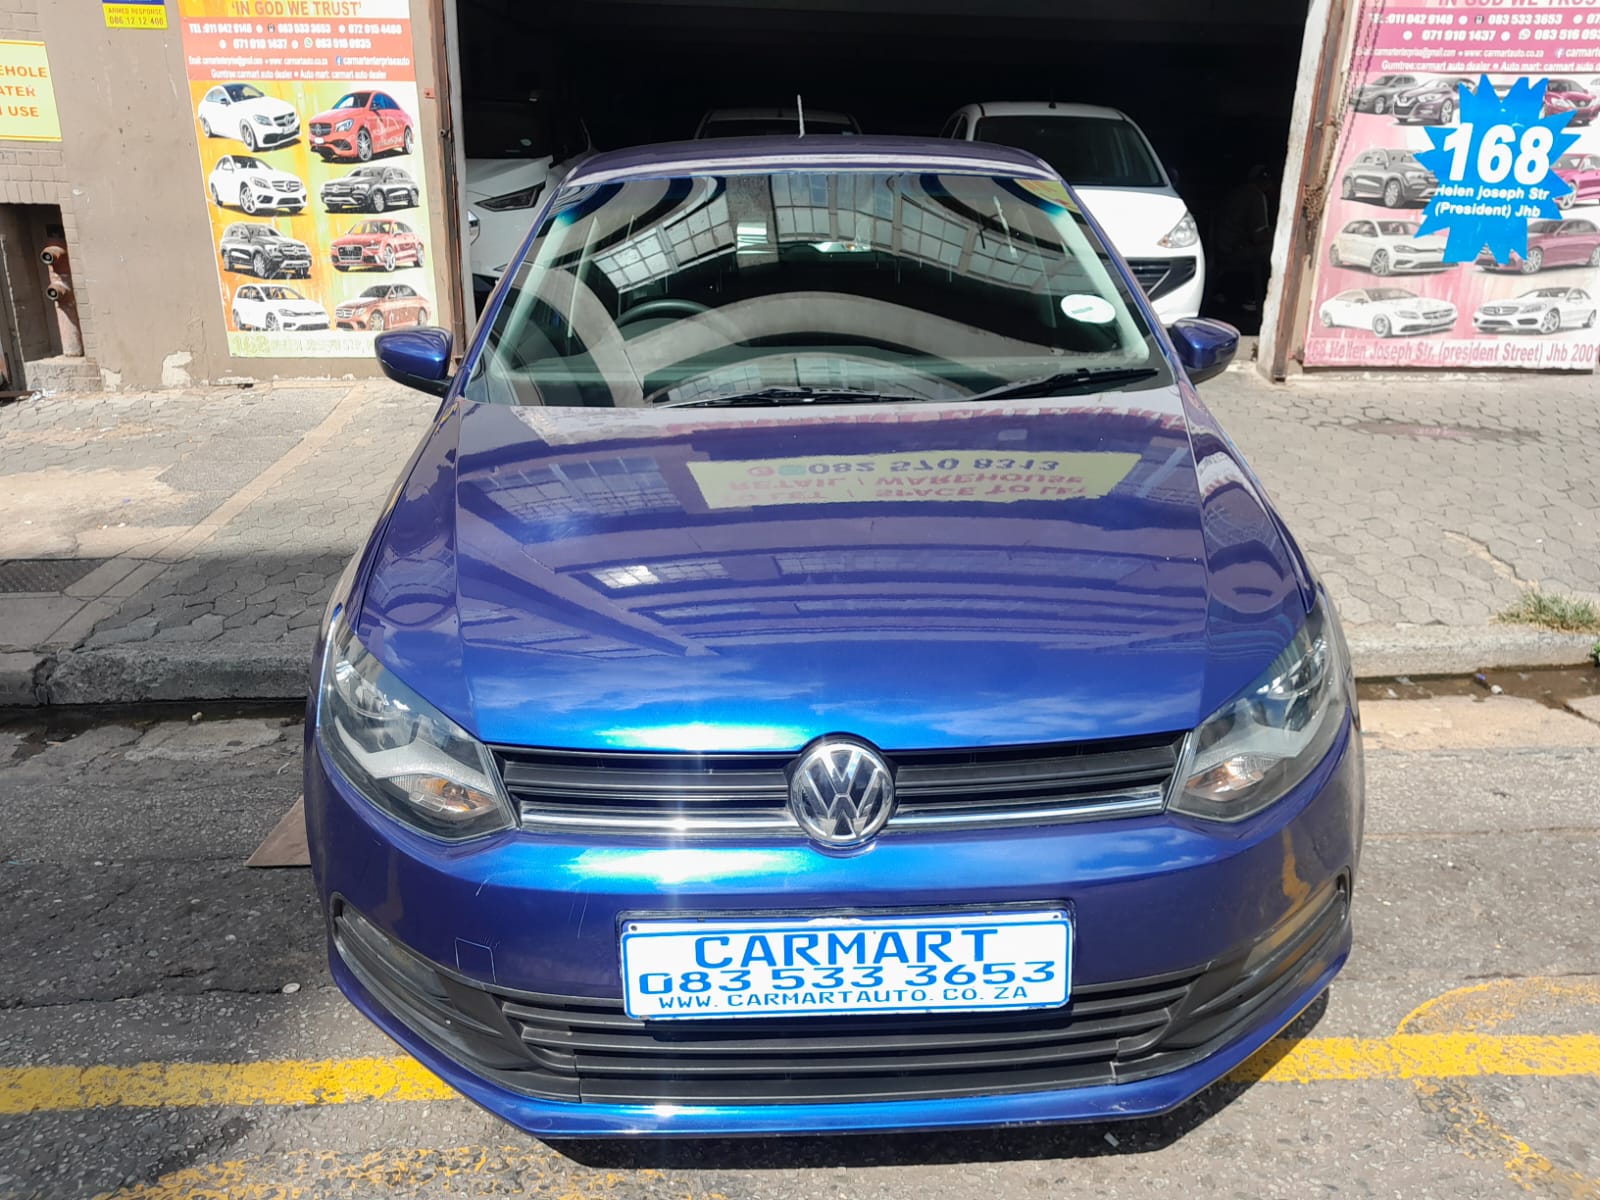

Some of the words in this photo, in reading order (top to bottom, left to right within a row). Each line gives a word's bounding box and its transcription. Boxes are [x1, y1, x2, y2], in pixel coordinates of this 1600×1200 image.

[255, 1, 284, 16] GOD
[288, 1, 310, 16] WE
[1488, 14, 1510, 25] 083
[1511, 14, 1533, 25] 533
[1534, 14, 1563, 25] 3653
[7, 105, 40, 118] USE
[1443, 122, 1554, 185] 168
[1528, 187, 1551, 200] Str
[1434, 201, 1512, 219] (President)
[1514, 205, 1541, 218] Jhb
[1369, 340, 1412, 363] Joseph
[1502, 342, 1543, 364] Street)
[1546, 343, 1568, 362] Jhb
[694, 928, 999, 969] CARMART
[638, 970, 752, 995] 083
[771, 964, 885, 990] 533
[904, 960, 1055, 987] 3653
